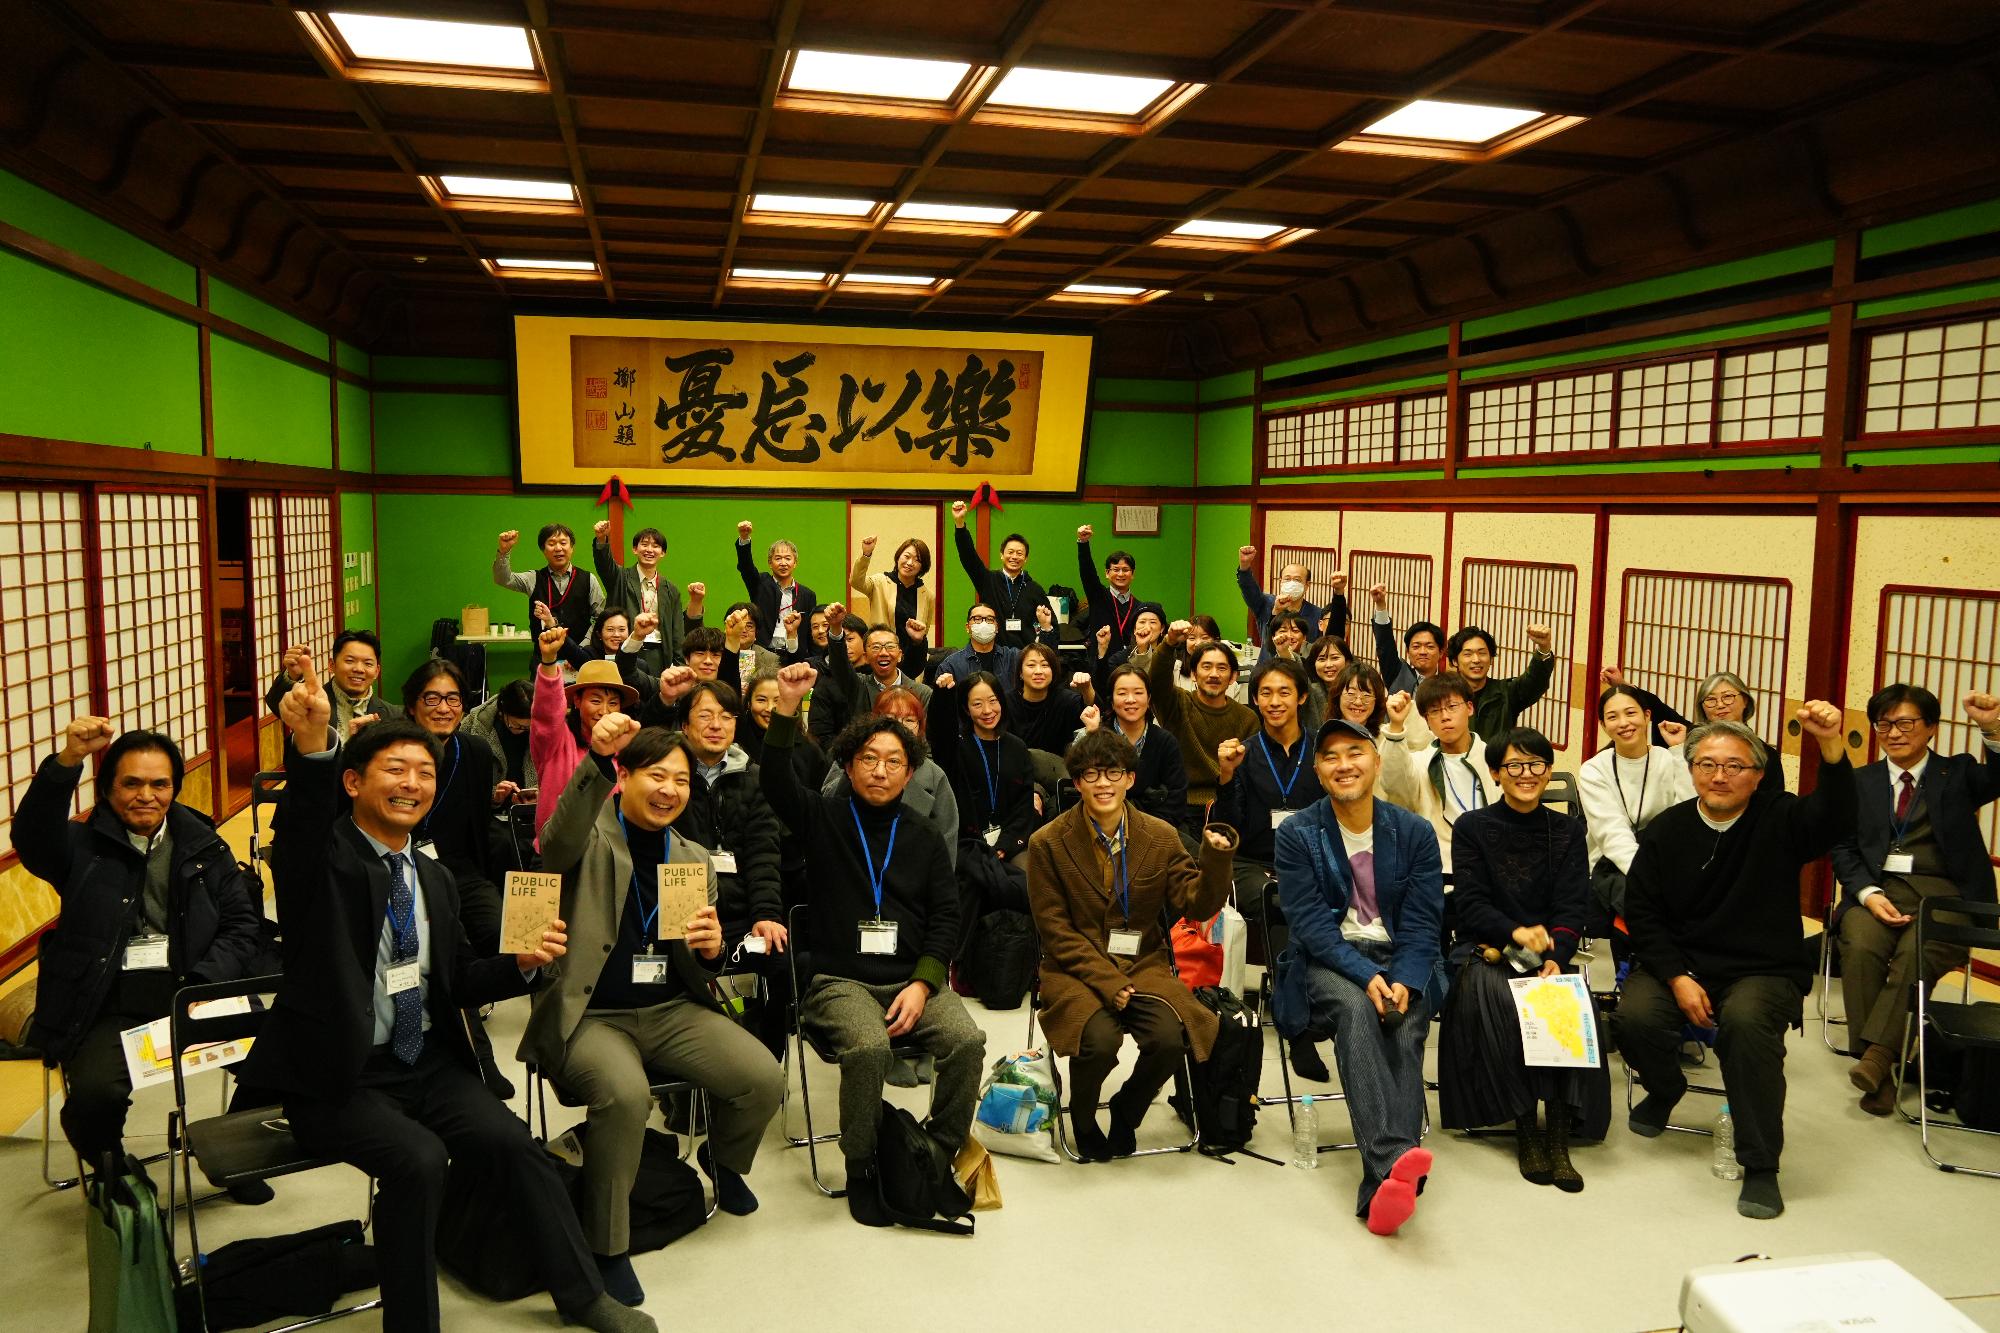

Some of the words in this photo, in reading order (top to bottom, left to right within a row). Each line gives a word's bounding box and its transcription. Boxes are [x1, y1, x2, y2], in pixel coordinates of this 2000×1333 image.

[663, 867, 704, 877] PUBLIC
[512, 875, 558, 888] PUBLIC
[664, 877, 687, 887] LIFE
[511, 887, 537, 897] LIFE
